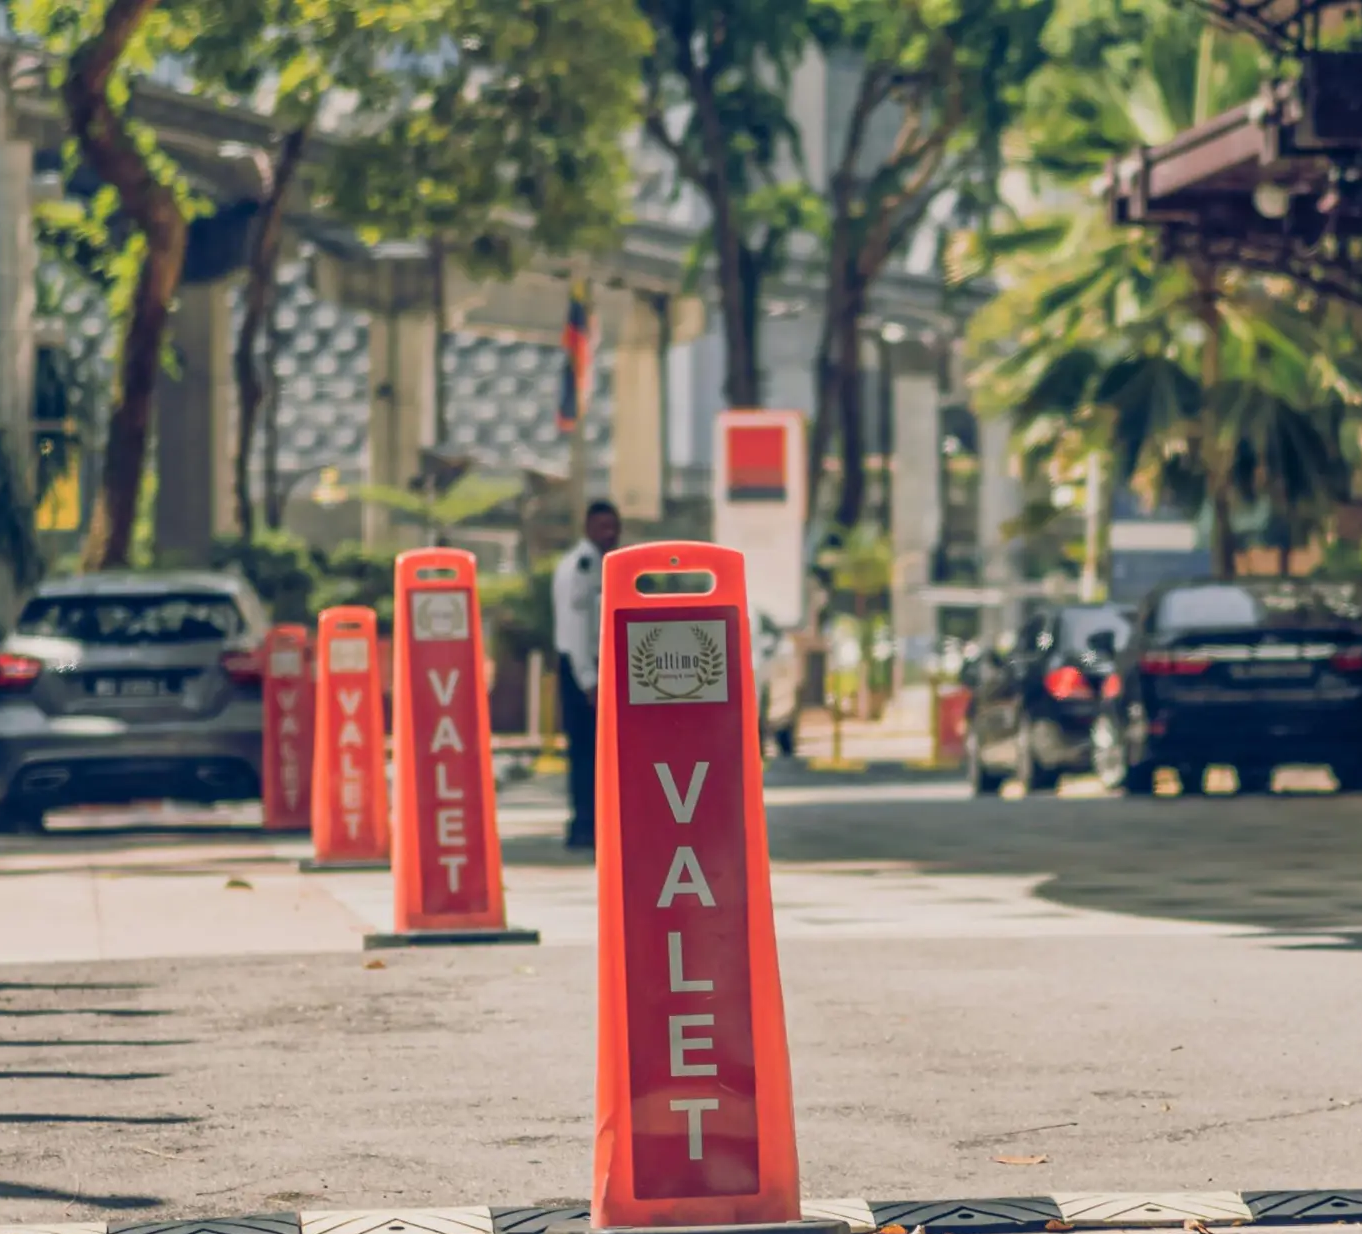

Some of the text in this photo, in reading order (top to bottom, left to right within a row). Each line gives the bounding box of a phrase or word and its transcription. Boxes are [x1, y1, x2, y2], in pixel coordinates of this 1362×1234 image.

[656, 651, 699, 670] ultimo
[276, 688, 300, 813] VALET
[337, 688, 364, 841] VALET
[427, 668, 468, 893] VALET
[654, 762, 719, 1160] VALET
